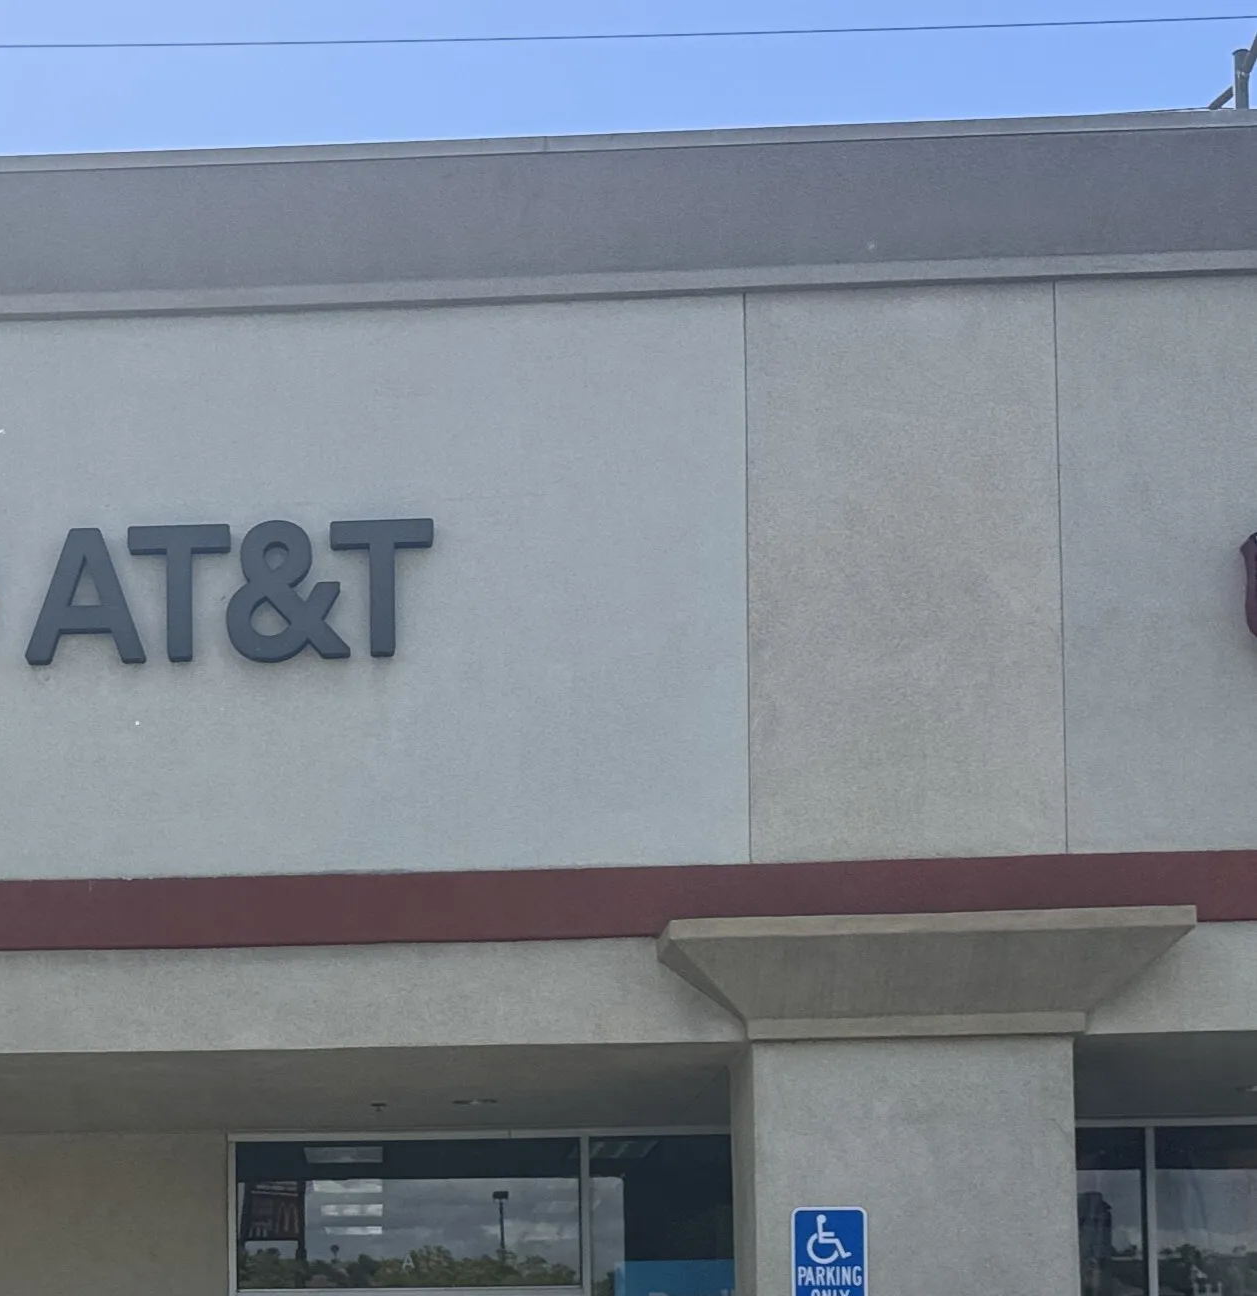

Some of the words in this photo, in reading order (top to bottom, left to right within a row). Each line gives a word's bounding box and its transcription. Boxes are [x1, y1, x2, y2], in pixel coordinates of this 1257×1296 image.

[25, 518, 433, 665] AT&T
[402, 1254, 415, 1271] A
[797, 1266, 862, 1286] PARKING
